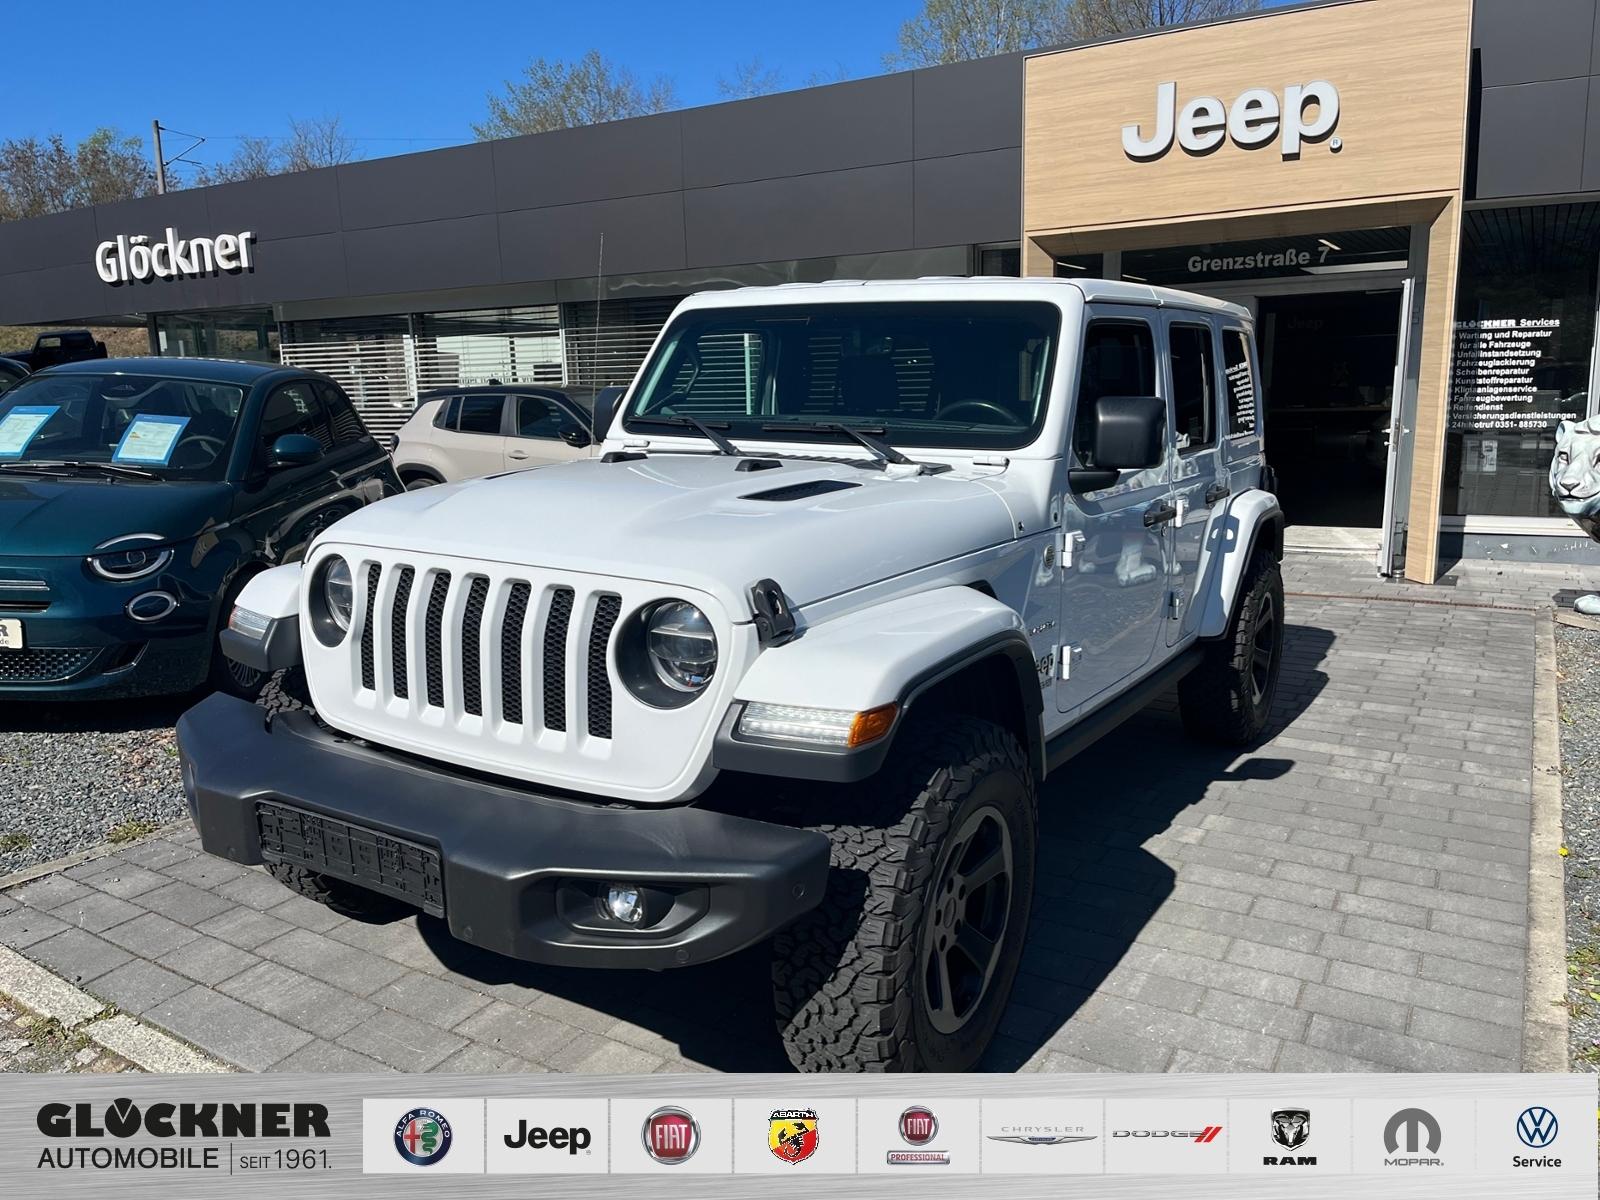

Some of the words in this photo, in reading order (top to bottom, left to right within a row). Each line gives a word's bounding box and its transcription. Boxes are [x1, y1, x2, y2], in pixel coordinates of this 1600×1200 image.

[1121, 80, 1340, 162] Jeep
[95, 227, 255, 283] Glöckner
[1187, 248, 1310, 273] Grenzstraße
[1318, 246, 1330, 264] 7
[1520, 318, 1560, 328] Services
[1459, 331, 1493, 340] Wartung
[1494, 331, 1510, 339] und
[1512, 330, 1552, 340] Reparatur
[1459, 341, 1471, 349] für
[1488, 341, 1532, 350] Fahrzeuge
[1457, 350, 1541, 359] Unfallinstandsetzung
[1456, 359, 1536, 368] Fahrzeuglackierung
[1456, 368, 1530, 377] Scheibenreparatur
[1455, 377, 1533, 386] Kunststoffreparatur
[1454, 385, 1537, 395] Klimaanlagenservice
[1454, 395, 1533, 404] Fahrzeugbewertung
[1452, 412, 1577, 421] Versicherungsdienstleistungen
